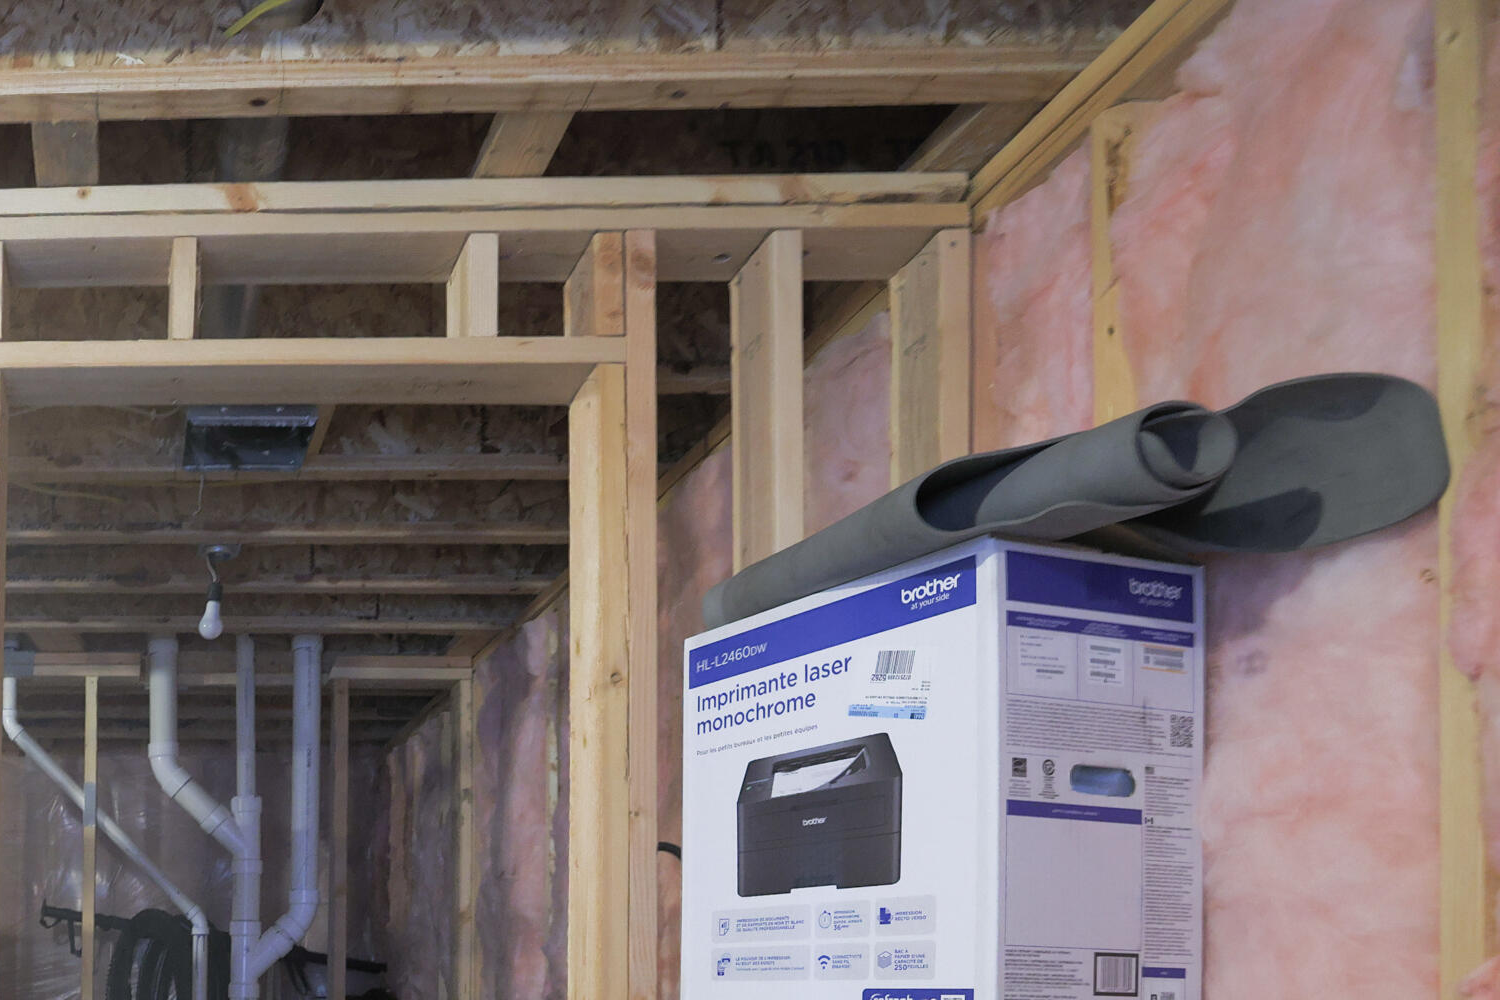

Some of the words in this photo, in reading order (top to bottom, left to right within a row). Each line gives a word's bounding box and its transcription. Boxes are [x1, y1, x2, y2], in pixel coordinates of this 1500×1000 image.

[901, 572, 961, 604] brother
[910, 602, 918, 611] at
[918, 598, 934, 611] your
[934, 592, 950, 605] side
[696, 671, 798, 713] Imprimante
[804, 655, 853, 683] laser
[696, 692, 817, 736] monochrome
[718, 743, 733, 754] petits
[773, 729, 794, 742] petites
[802, 816, 828, 827] brother
